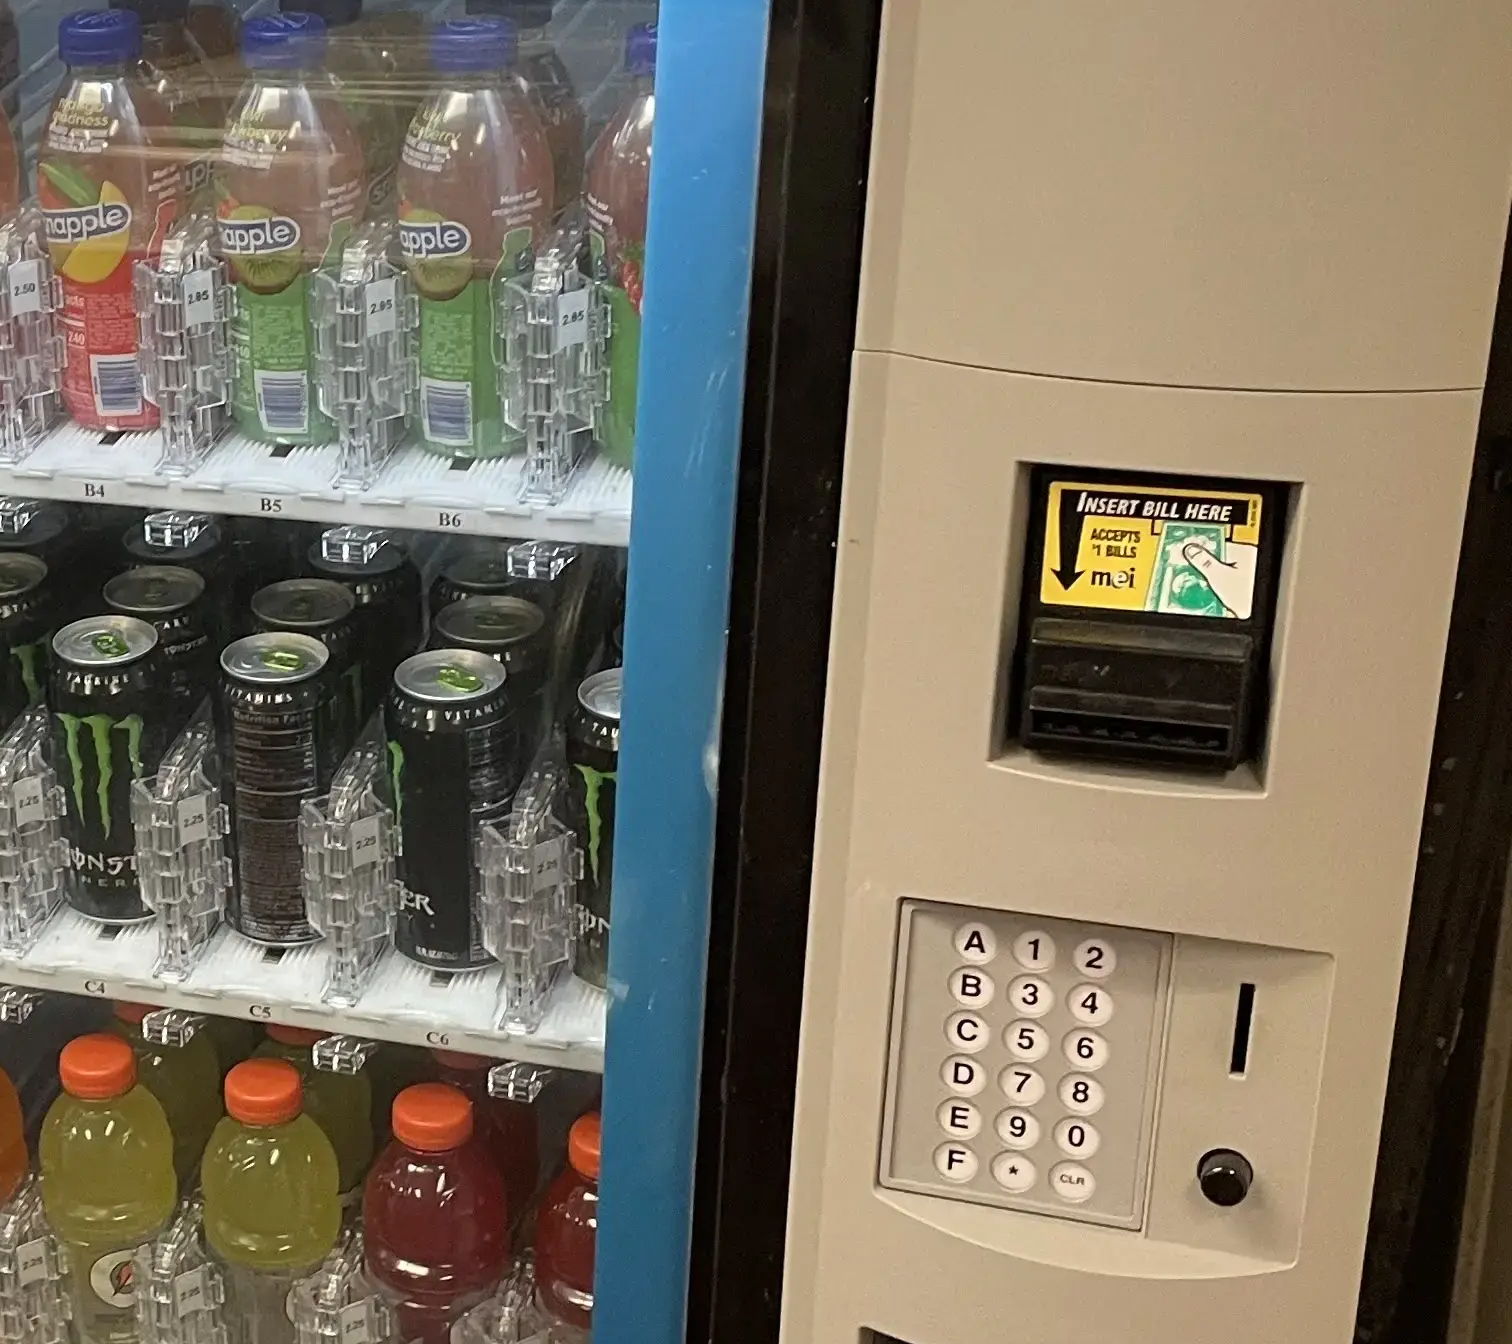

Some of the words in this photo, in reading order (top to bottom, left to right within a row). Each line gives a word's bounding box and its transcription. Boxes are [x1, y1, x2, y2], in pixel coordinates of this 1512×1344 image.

[14, 282, 36, 296] 2.50
[67, 331, 85, 346] 240
[84, 483, 105, 498] B4
[260, 497, 282, 513] B5
[1077, 492, 1139, 516] INSERT
[1142, 501, 1179, 519] BILL
[1185, 503, 1232, 522] HERE
[438, 512, 461, 527] B6
[1090, 528, 1140, 543] ACCEPTS
[1106, 545, 1136, 558] BILLS
[1090, 567, 1136, 589] mei
[183, 813, 205, 829] 2.25
[356, 835, 377, 850] 2.25
[963, 930, 987, 954] A
[1028, 938, 1041, 961] 1
[1086, 947, 1104, 969] 2
[85, 980, 106, 994] C4
[961, 974, 982, 997] B
[1021, 983, 1039, 1006] 3
[1080, 992, 1099, 1014] 4
[249, 1003, 272, 1018] C5
[426, 1030, 450, 1045] C6
[956, 1019, 978, 1042] C
[1017, 1028, 1035, 1050] 5
[1076, 1037, 1094, 1059] 6
[953, 1063, 975, 1086] D
[1013, 1072, 1032, 1094] 7
[1071, 1081, 1090, 1103] 8
[950, 1106, 970, 1129] E
[1009, 1116, 1027, 1138] 9
[1068, 1125, 1086, 1147] 0
[947, 1150, 967, 1171] F
[1059, 1172, 1085, 1186] CLR
